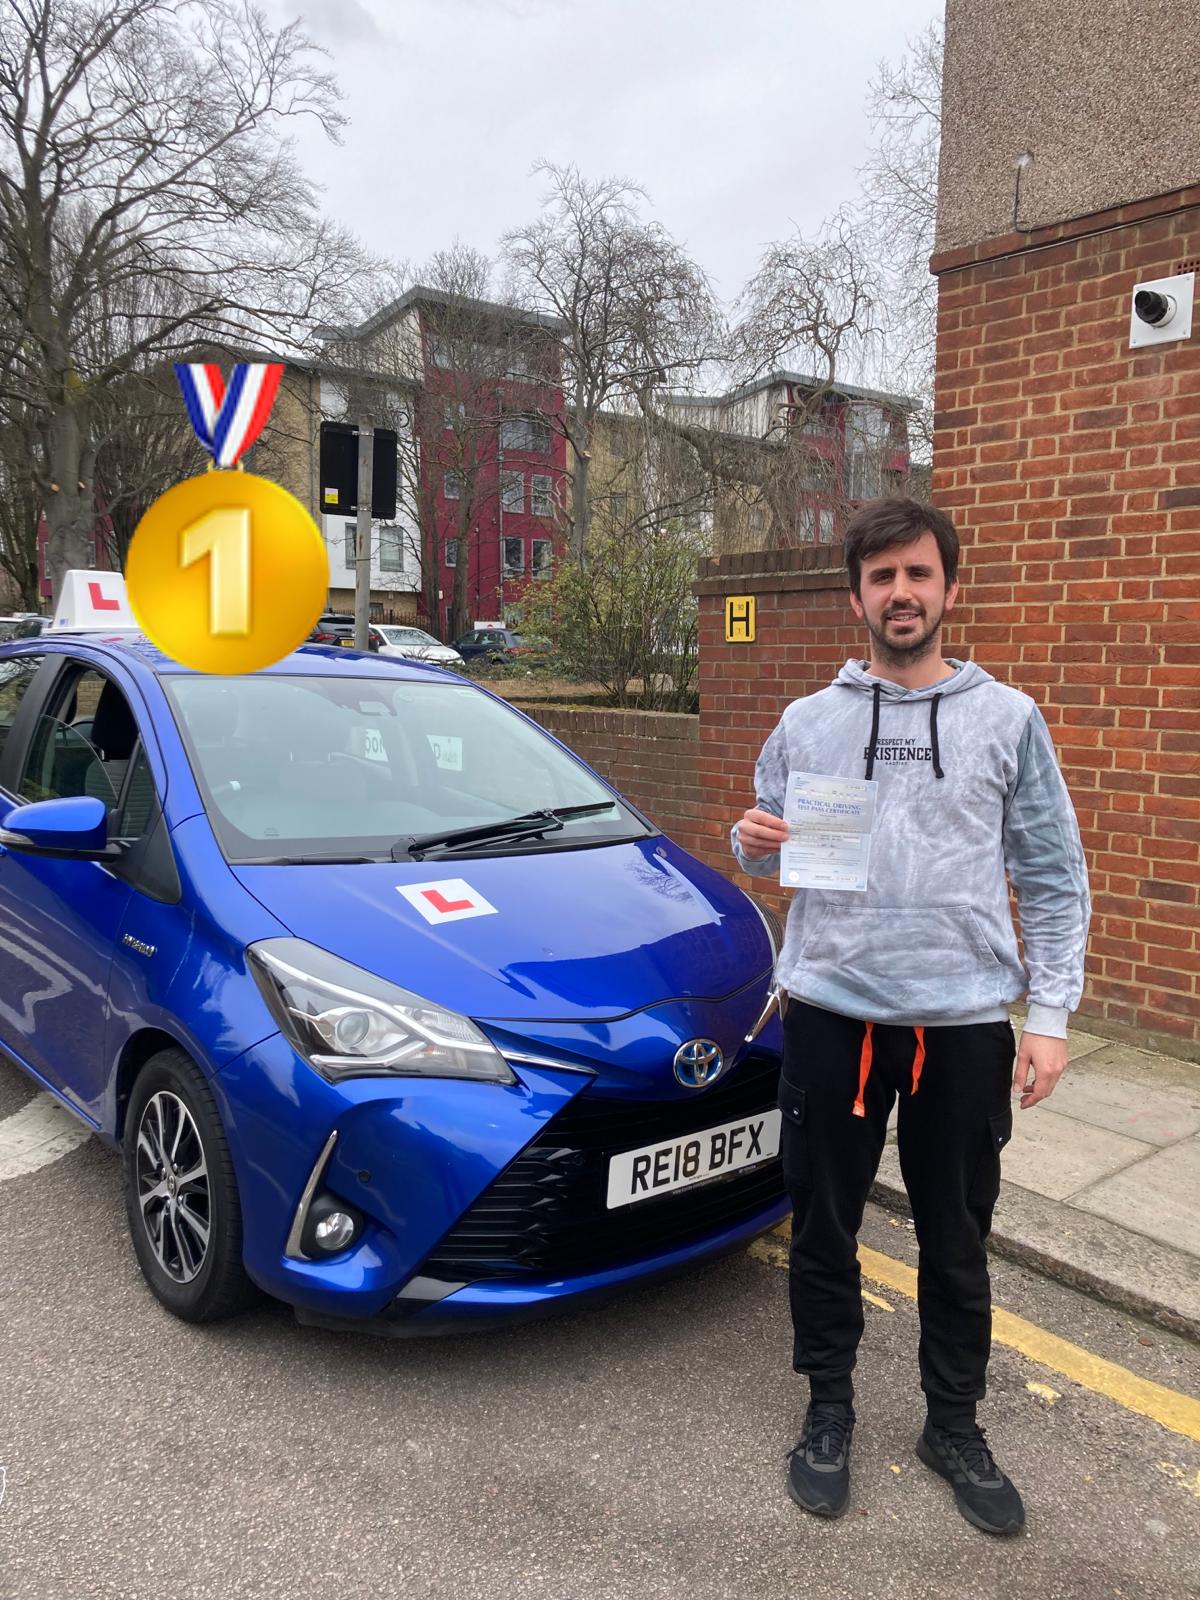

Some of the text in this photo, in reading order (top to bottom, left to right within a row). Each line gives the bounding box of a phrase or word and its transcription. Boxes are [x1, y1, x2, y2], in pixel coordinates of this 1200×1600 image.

[88, 582, 120, 610] L
[730, 601, 749, 637] H
[864, 746, 932, 761] EXISTENCE
[876, 738, 916, 746] RESPECT MY
[797, 799, 831, 808] PRACTICAL
[420, 889, 475, 914] L
[631, 1120, 764, 1195] RE18 BFX
